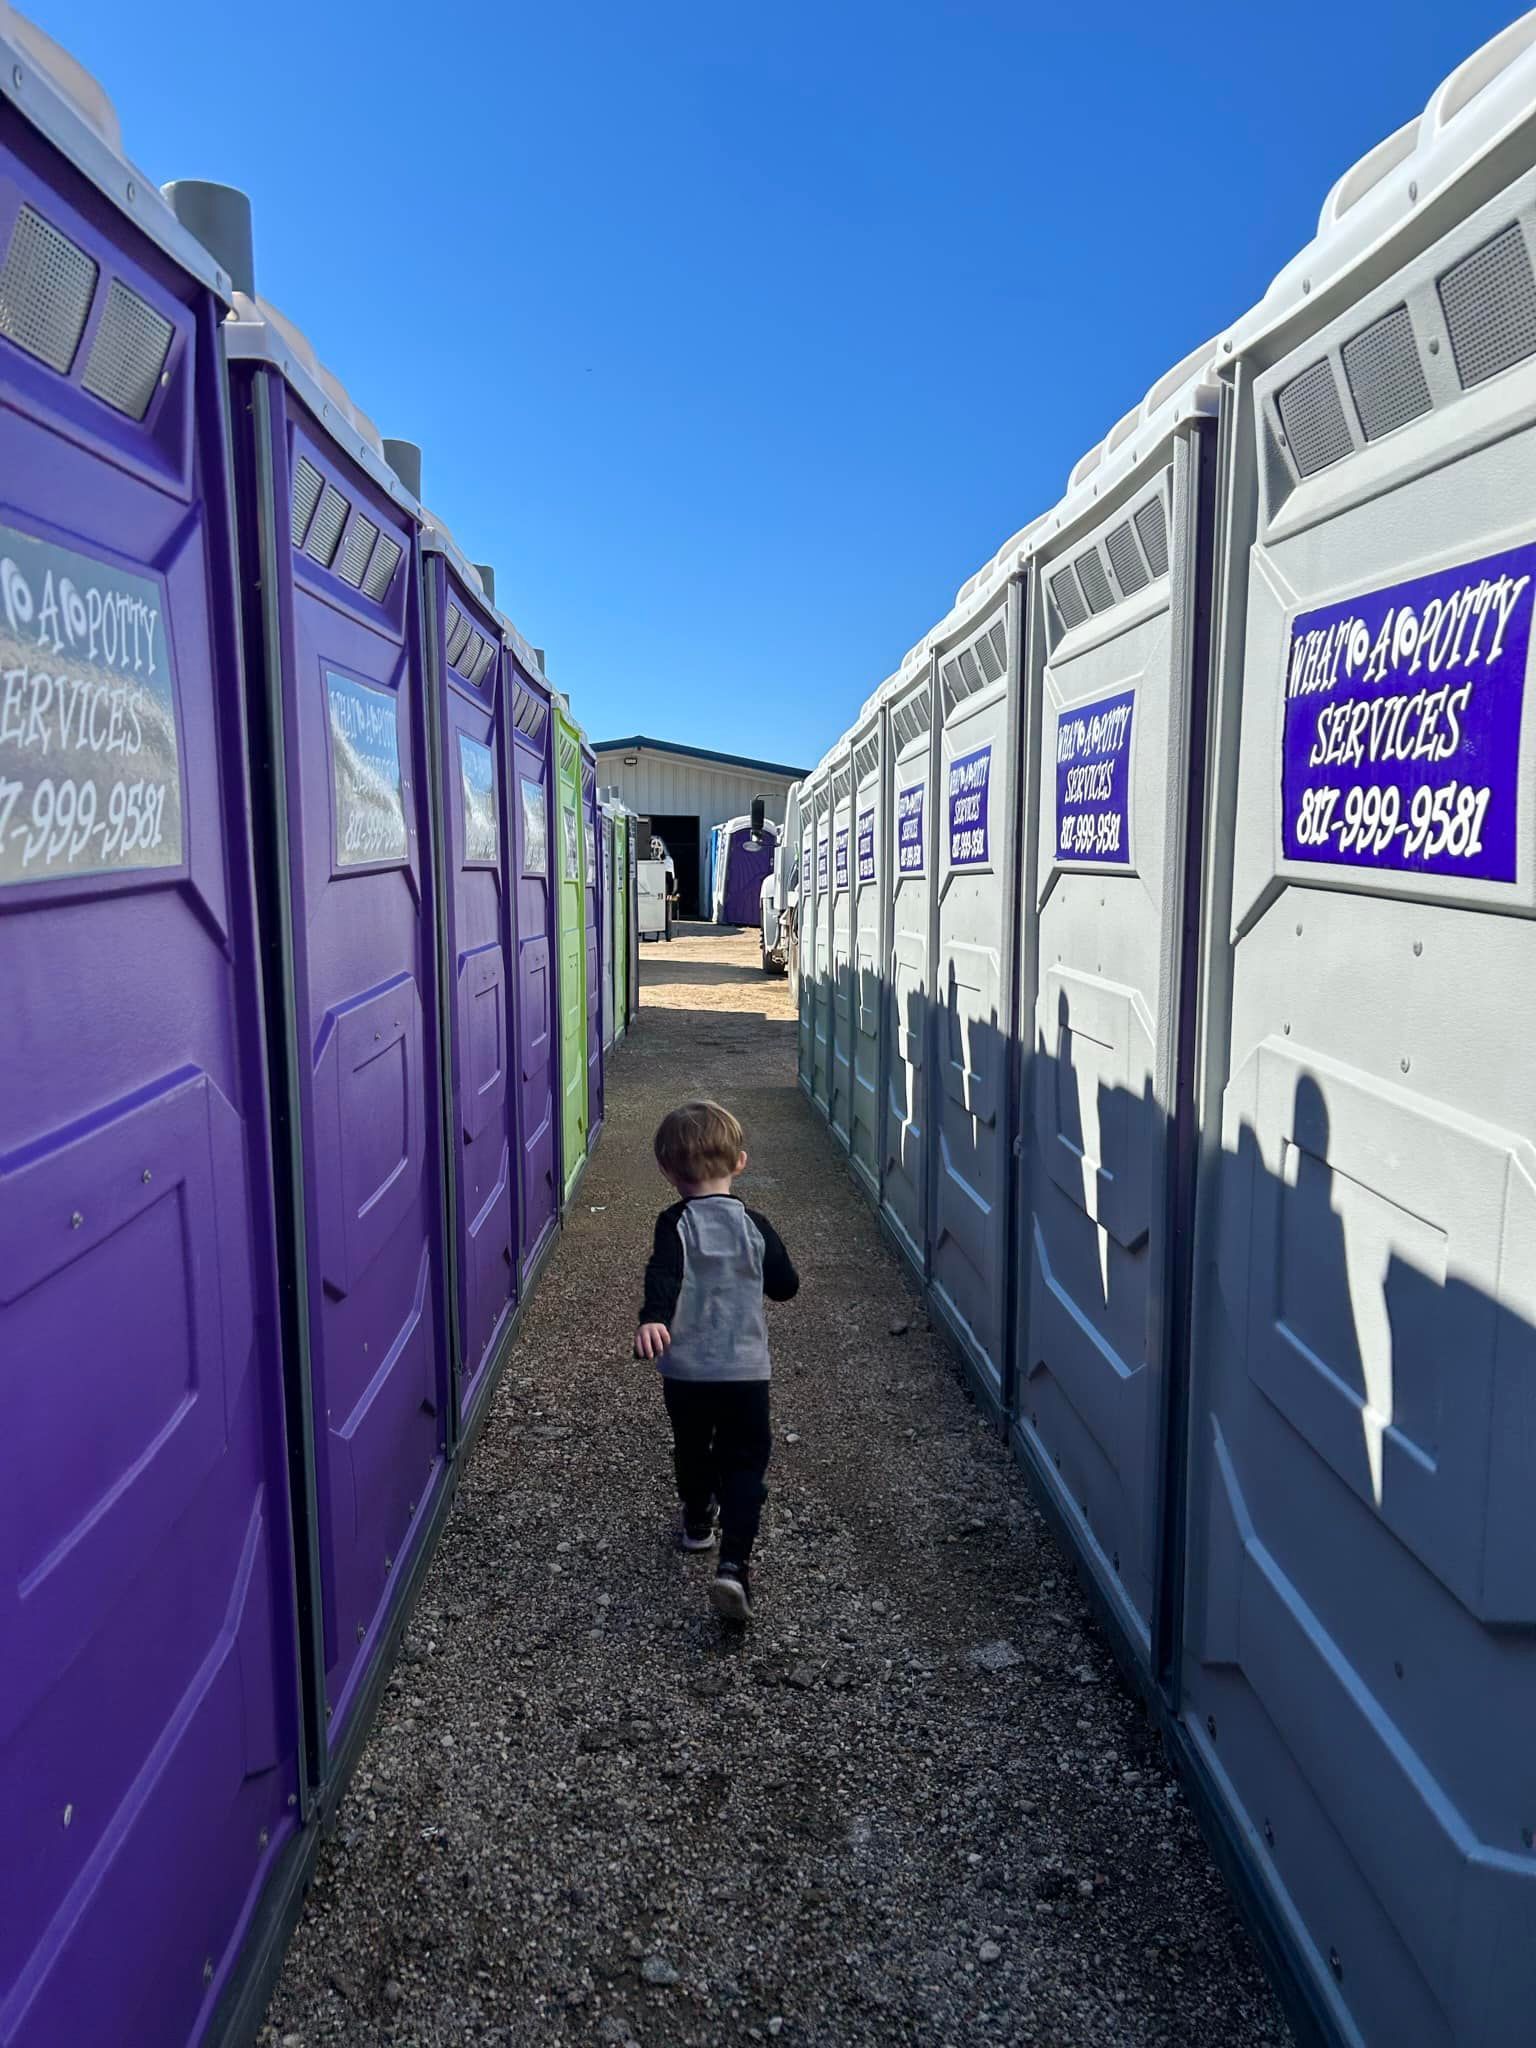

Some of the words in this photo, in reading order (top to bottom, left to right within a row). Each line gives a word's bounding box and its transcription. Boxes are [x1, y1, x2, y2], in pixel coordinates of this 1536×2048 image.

[37, 569, 65, 656] A
[87, 586, 159, 676] POTTY
[1289, 617, 1353, 698] WHAT
[1363, 608, 1394, 682] A
[1409, 574, 1531, 676] POTTY
[0, 665, 143, 757] ERVICES
[1310, 682, 1472, 768] SERVICES
[0, 776, 166, 867] 7-999-9581
[1064, 759, 1115, 804] SERVICES
[1296, 780, 1490, 860] 817-999-9581
[1060, 811, 1122, 855] 817-999-9581
